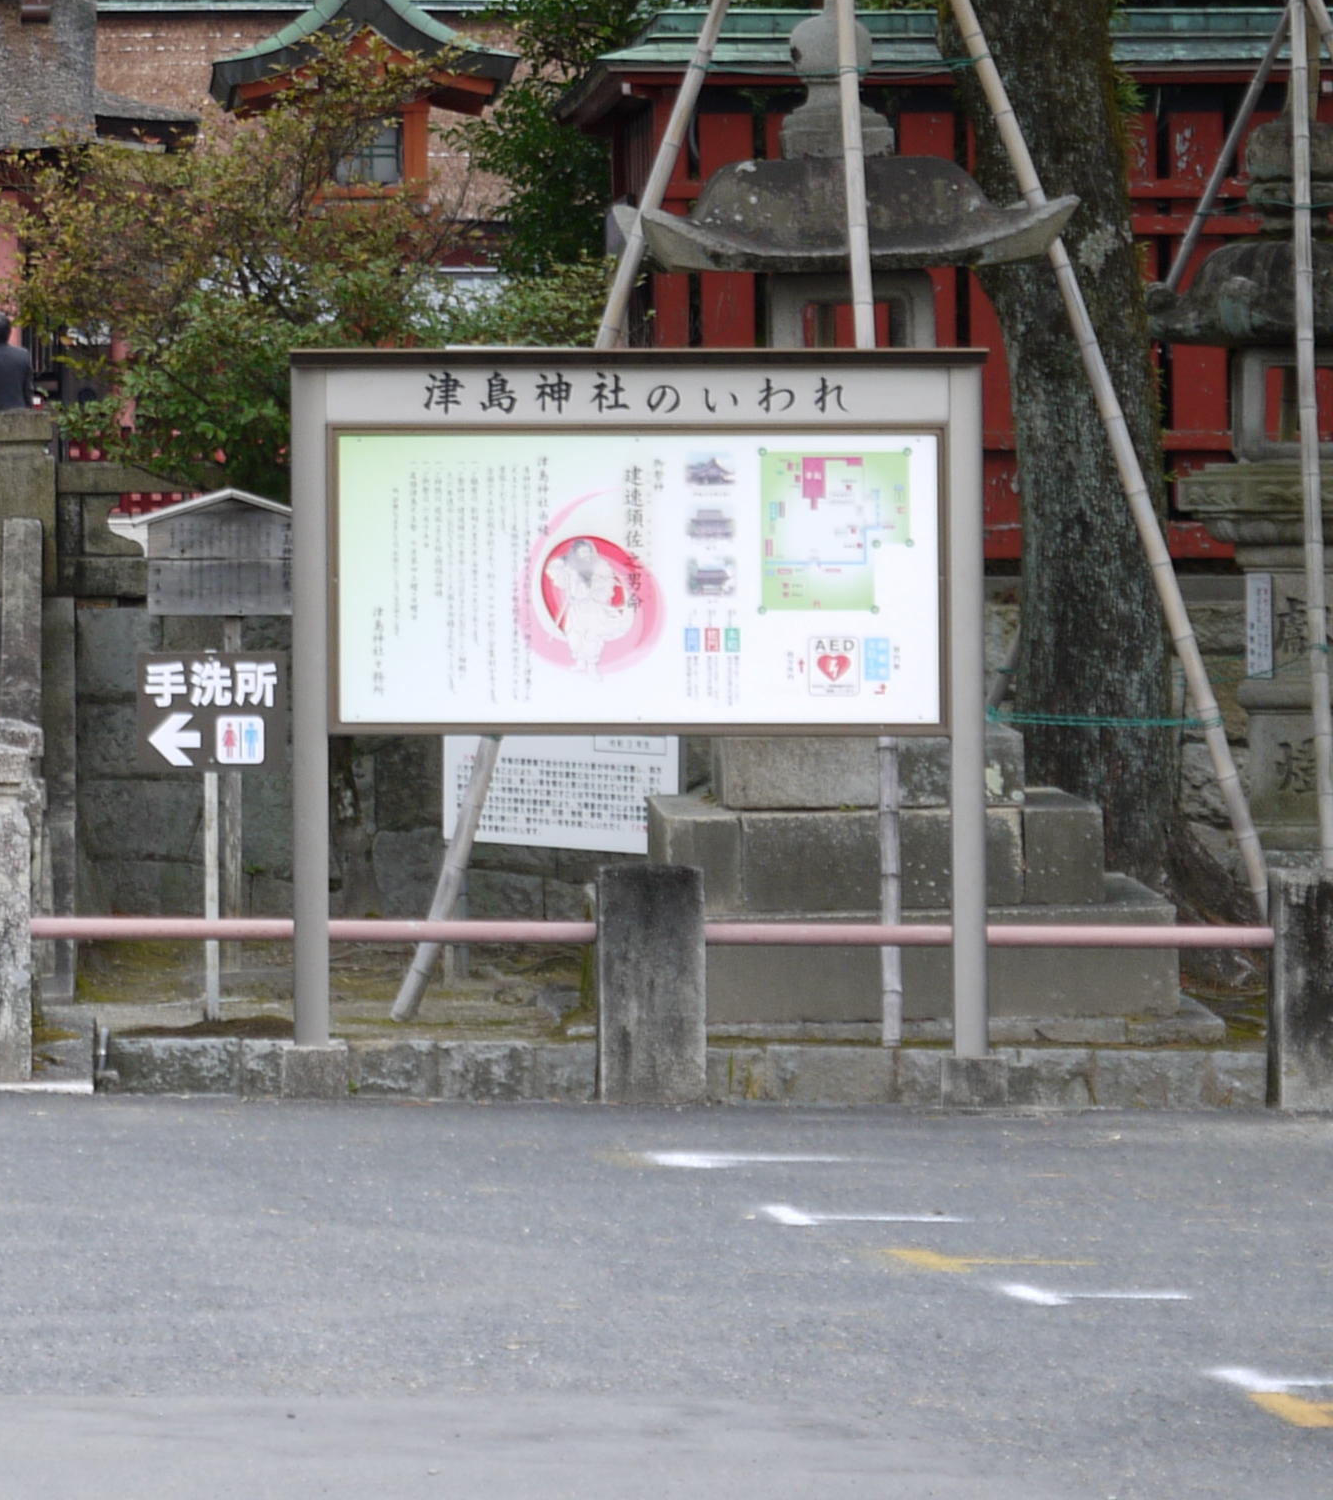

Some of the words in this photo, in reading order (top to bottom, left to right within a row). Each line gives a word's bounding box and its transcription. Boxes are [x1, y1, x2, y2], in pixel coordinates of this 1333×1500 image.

[424, 372, 849, 415] 津島神社のいわれ
[625, 465, 644, 613] 建速須佐之男命
[815, 639, 855, 652] AED
[144, 660, 278, 709] 手洗所
